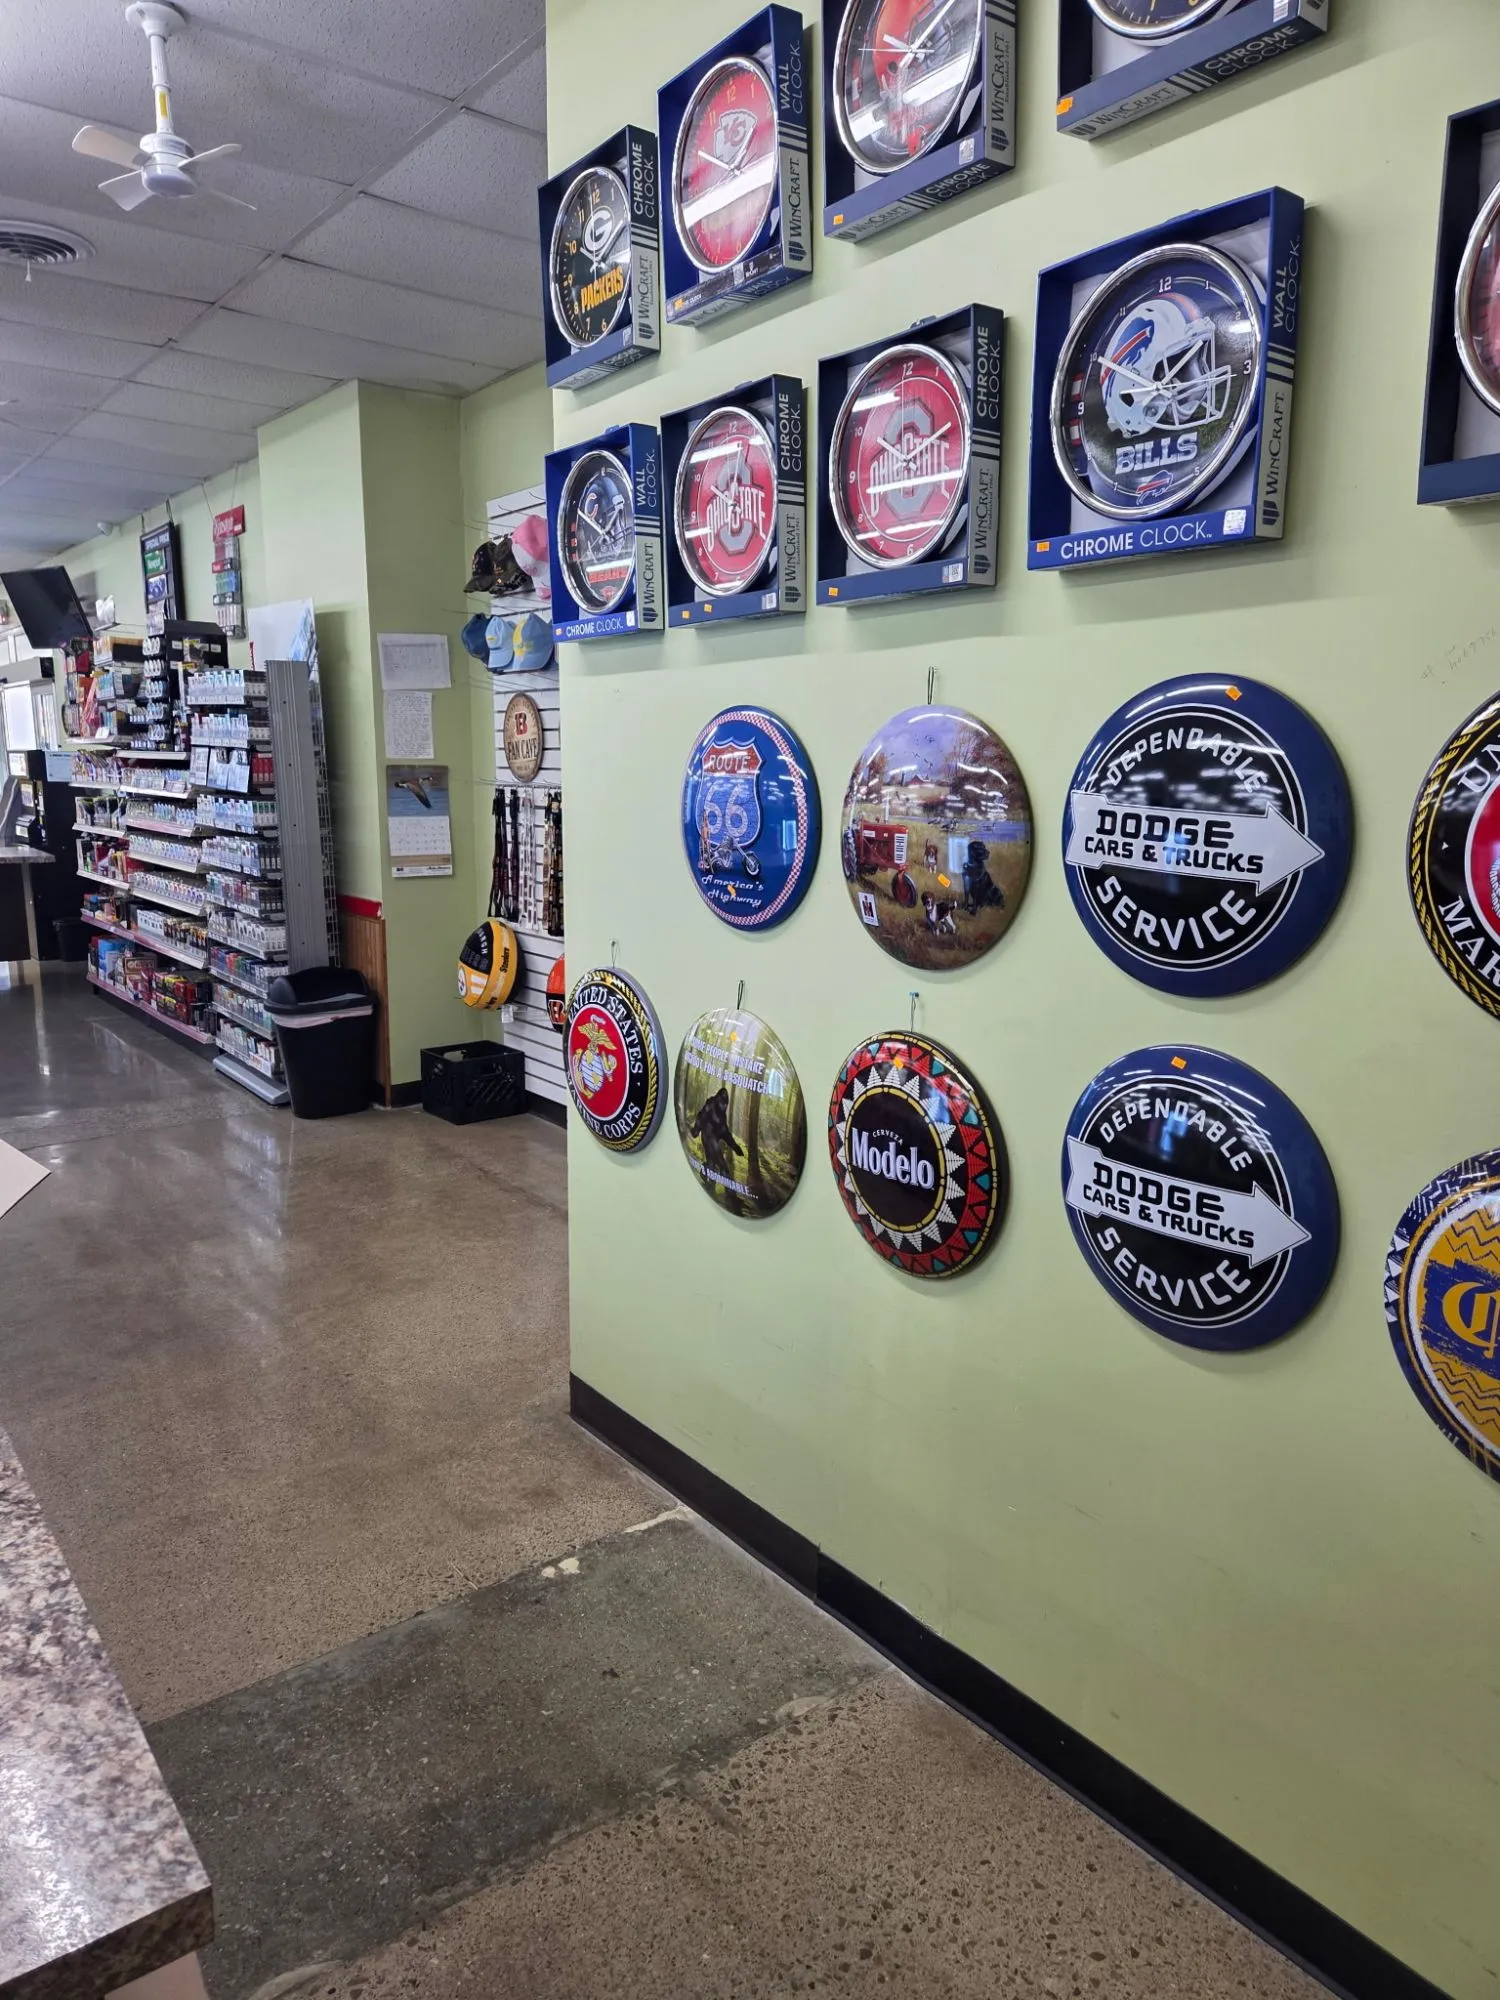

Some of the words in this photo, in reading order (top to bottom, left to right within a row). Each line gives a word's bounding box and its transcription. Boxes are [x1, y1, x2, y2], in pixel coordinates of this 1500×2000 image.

[1205, 25, 1299, 71] CHROME
[1217, 39, 1297, 76] CLOCK
[779, 63, 789, 109] WALL
[632, 142, 643, 215] CHROME
[645, 161, 655, 219] CLOCK
[925, 162, 990, 194] CHROME
[592, 188, 600, 205] 12
[578, 208, 585, 225] 11
[569, 240, 577, 254] 10
[581, 266, 624, 314] PACKERS
[1159, 277, 1172, 293] 12
[1205, 280, 1211, 290] 1
[1273, 266, 1287, 328] WALL
[574, 301, 579, 315] 8
[585, 317, 591, 331] 7
[1119, 307, 1126, 317] 11
[601, 318, 607, 333] 6
[902, 361, 914, 376] 12
[935, 367, 939, 377] 1
[977, 326, 989, 417] CHROME
[1089, 352, 1098, 362] 10
[1243, 360, 1252, 374] 3
[989, 346, 1000, 420] CLOCK
[1078, 402, 1085, 415] 9
[729, 421, 737, 433] 12
[780, 393, 789, 471] CHROME
[791, 408, 801, 472] CLOCK
[855, 427, 863, 436] 10
[1115, 431, 1198, 475] BILLS
[1265, 392, 1284, 497] WINCRAFT
[636, 468, 645, 506] WALL
[647, 452, 657, 507] CLOCK
[694, 474, 700, 482] 10
[849, 471, 856, 483] 9
[1194, 467, 1200, 477] 5
[691, 513, 696, 522] 9
[858, 513, 863, 523] 8
[975, 468, 990, 549] WINCRAFT
[784, 513, 796, 583] WINCRAFT
[879, 541, 884, 551] 7
[907, 544, 914, 556] 6
[1060, 532, 1134, 560] CHROME
[566, 620, 595, 637] CHROME
[507, 741, 520, 760] FAN
[520, 737, 537, 759] CAVE
[709, 755, 750, 771] ROUTE
[1106, 727, 1268, 793] DEPENDABLE
[704, 783, 749, 838] 66
[1095, 809, 1235, 849] DODGE
[1085, 837, 1134, 859] CARS
[1142, 845, 1158, 862] &
[1162, 846, 1264, 874] TRUCKS
[1096, 875, 1257, 950] SERVICE
[568, 985, 608, 1024] UNITED
[606, 995, 643, 1075] STATES
[705, 1045, 729, 1063] PEOPLE
[729, 1052, 766, 1075] MISTAKE
[703, 1060, 716, 1076] FOR
[723, 1071, 770, 1095] SASQUATCH
[567, 1071, 602, 1135] MARINE
[603, 1102, 642, 1139] CORPS
[872, 1129, 904, 1146] CERVEZA
[1099, 1097, 1253, 1172] DEPENDABLE
[851, 1127, 935, 1190] Modelo
[1092, 1161, 1225, 1221] DODGE
[1083, 1183, 1131, 1216] CARS
[1138, 1204, 1154, 1224] &
[1157, 1209, 1255, 1248] TRUCKS
[1096, 1226, 1251, 1310] SERVICE
